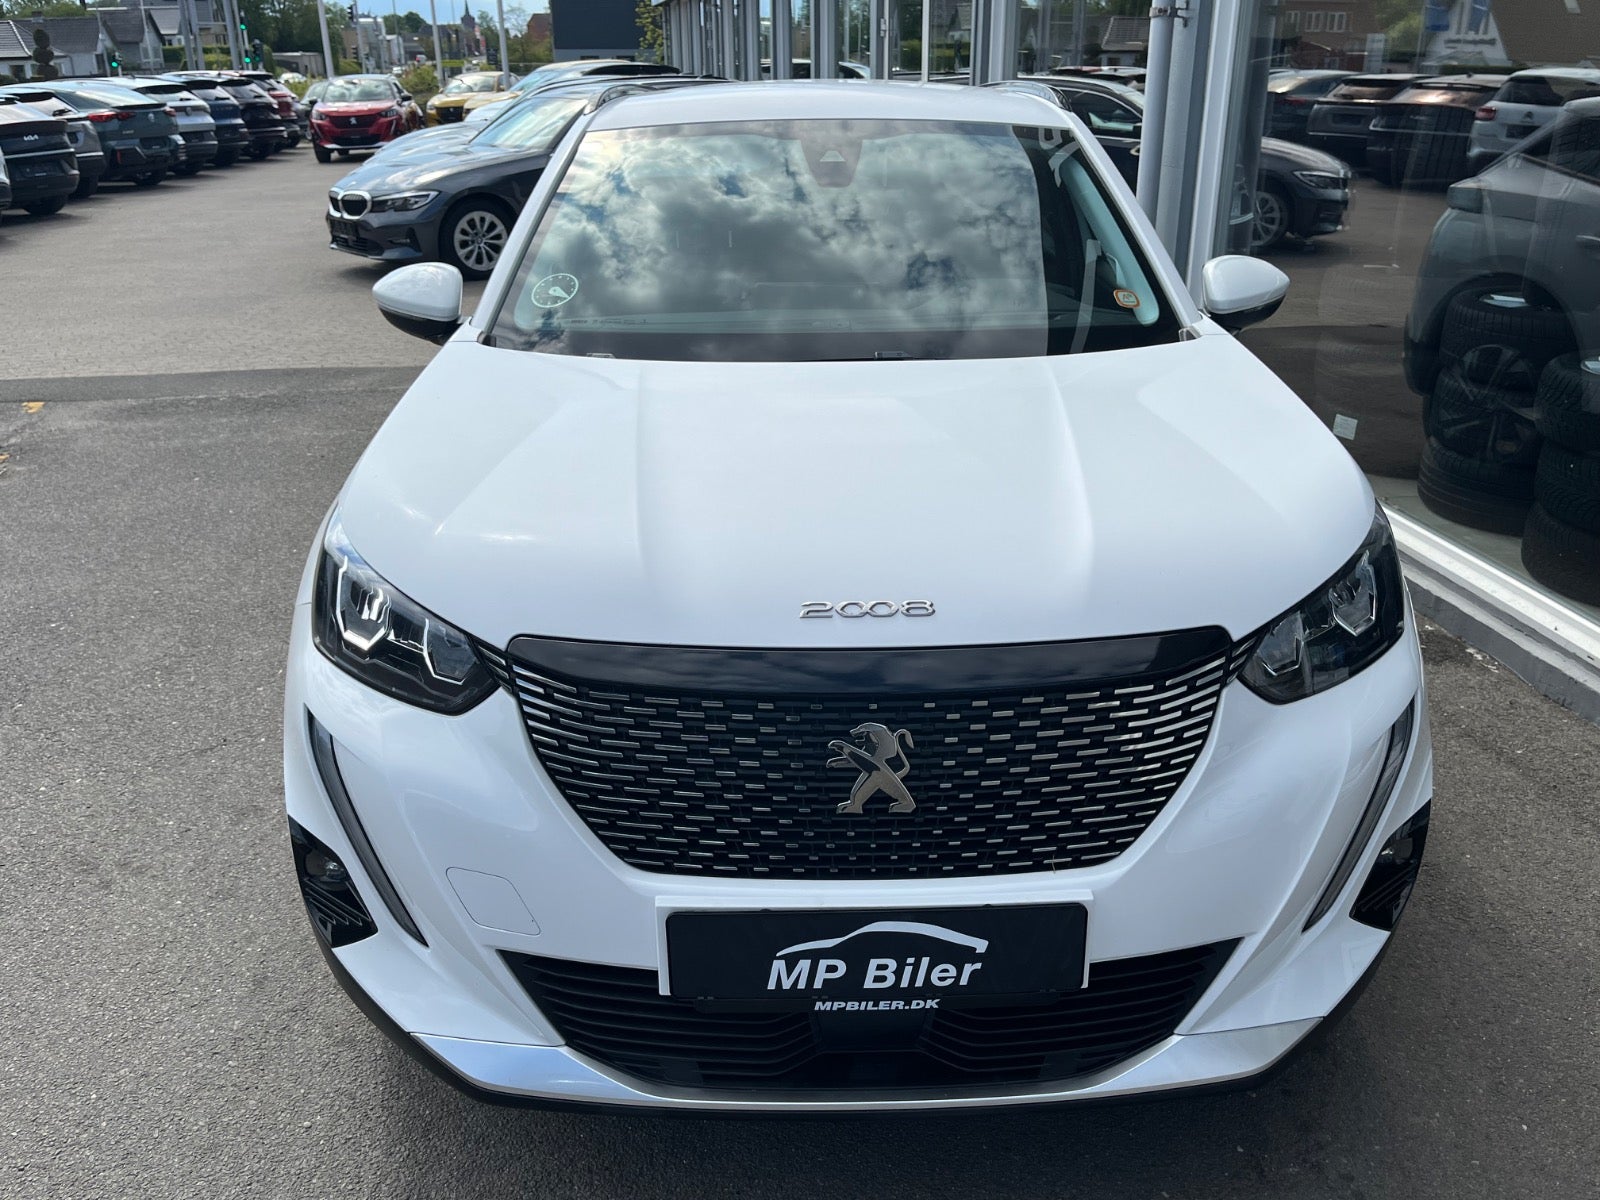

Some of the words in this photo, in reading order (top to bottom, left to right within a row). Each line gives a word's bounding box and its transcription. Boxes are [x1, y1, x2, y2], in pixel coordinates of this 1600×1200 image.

[800, 600, 936, 619] 2008
[766, 959, 847, 990] MP
[863, 957, 982, 989] Biler
[814, 998, 941, 1012] MPBILER.DK
